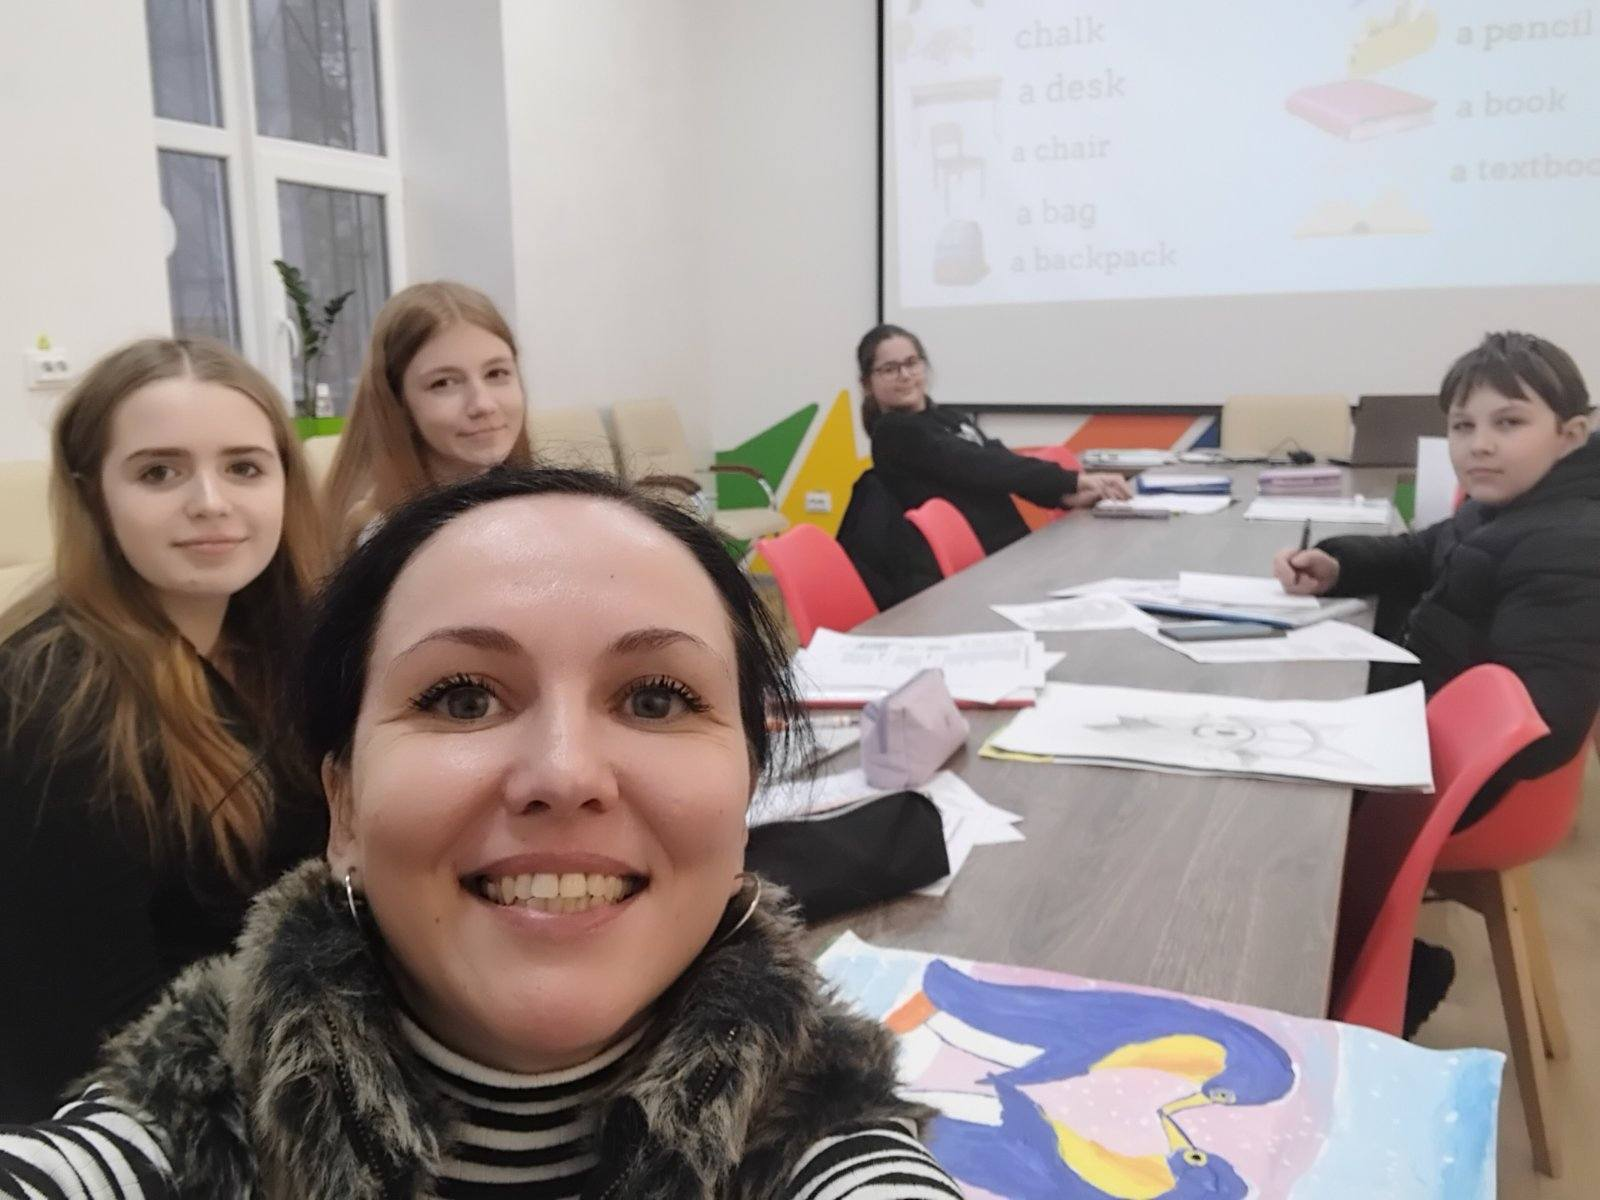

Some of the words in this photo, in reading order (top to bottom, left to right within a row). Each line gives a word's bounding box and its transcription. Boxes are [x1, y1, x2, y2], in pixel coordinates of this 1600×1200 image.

[1015, 14, 1106, 50] chalk
[1456, 25, 1474, 47] a
[1483, 9, 1594, 51] pencil
[1019, 83, 1036, 105] a
[1045, 67, 1126, 103] desk
[1455, 98, 1473, 119] a
[1485, 86, 1568, 117] book
[1011, 144, 1026, 163] a
[1034, 133, 1111, 162] chair
[1451, 164, 1468, 184] a
[1016, 204, 1033, 226] a
[1042, 198, 1097, 230] bag
[1010, 254, 1026, 274] a
[1034, 240, 1178, 275] backpack
